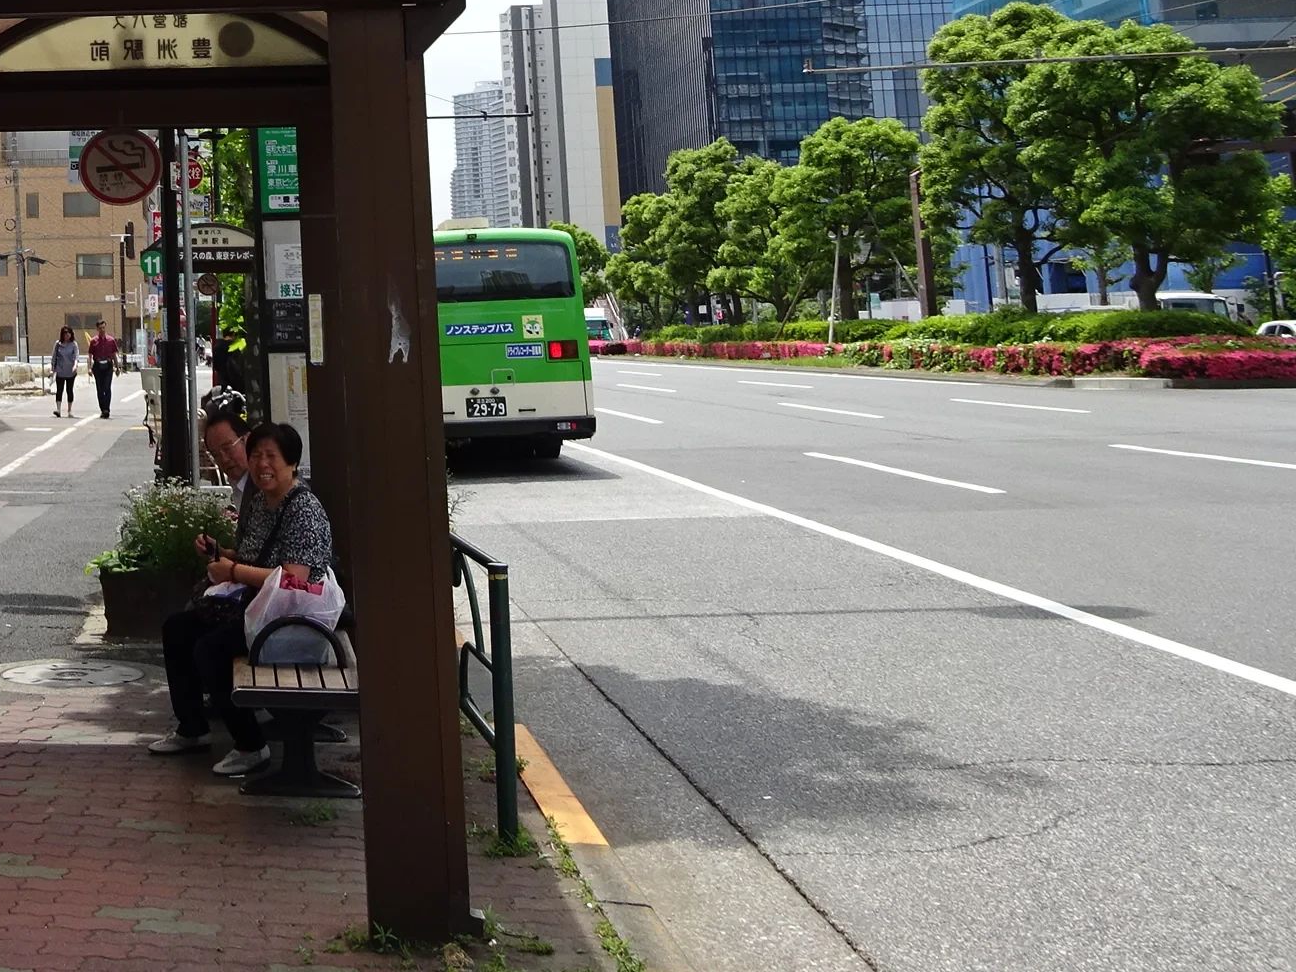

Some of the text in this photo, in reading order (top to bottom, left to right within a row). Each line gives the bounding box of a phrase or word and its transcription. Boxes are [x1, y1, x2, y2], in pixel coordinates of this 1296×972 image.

[144, 255, 160, 274] 11
[446, 323, 513, 335] ノンステップバス
